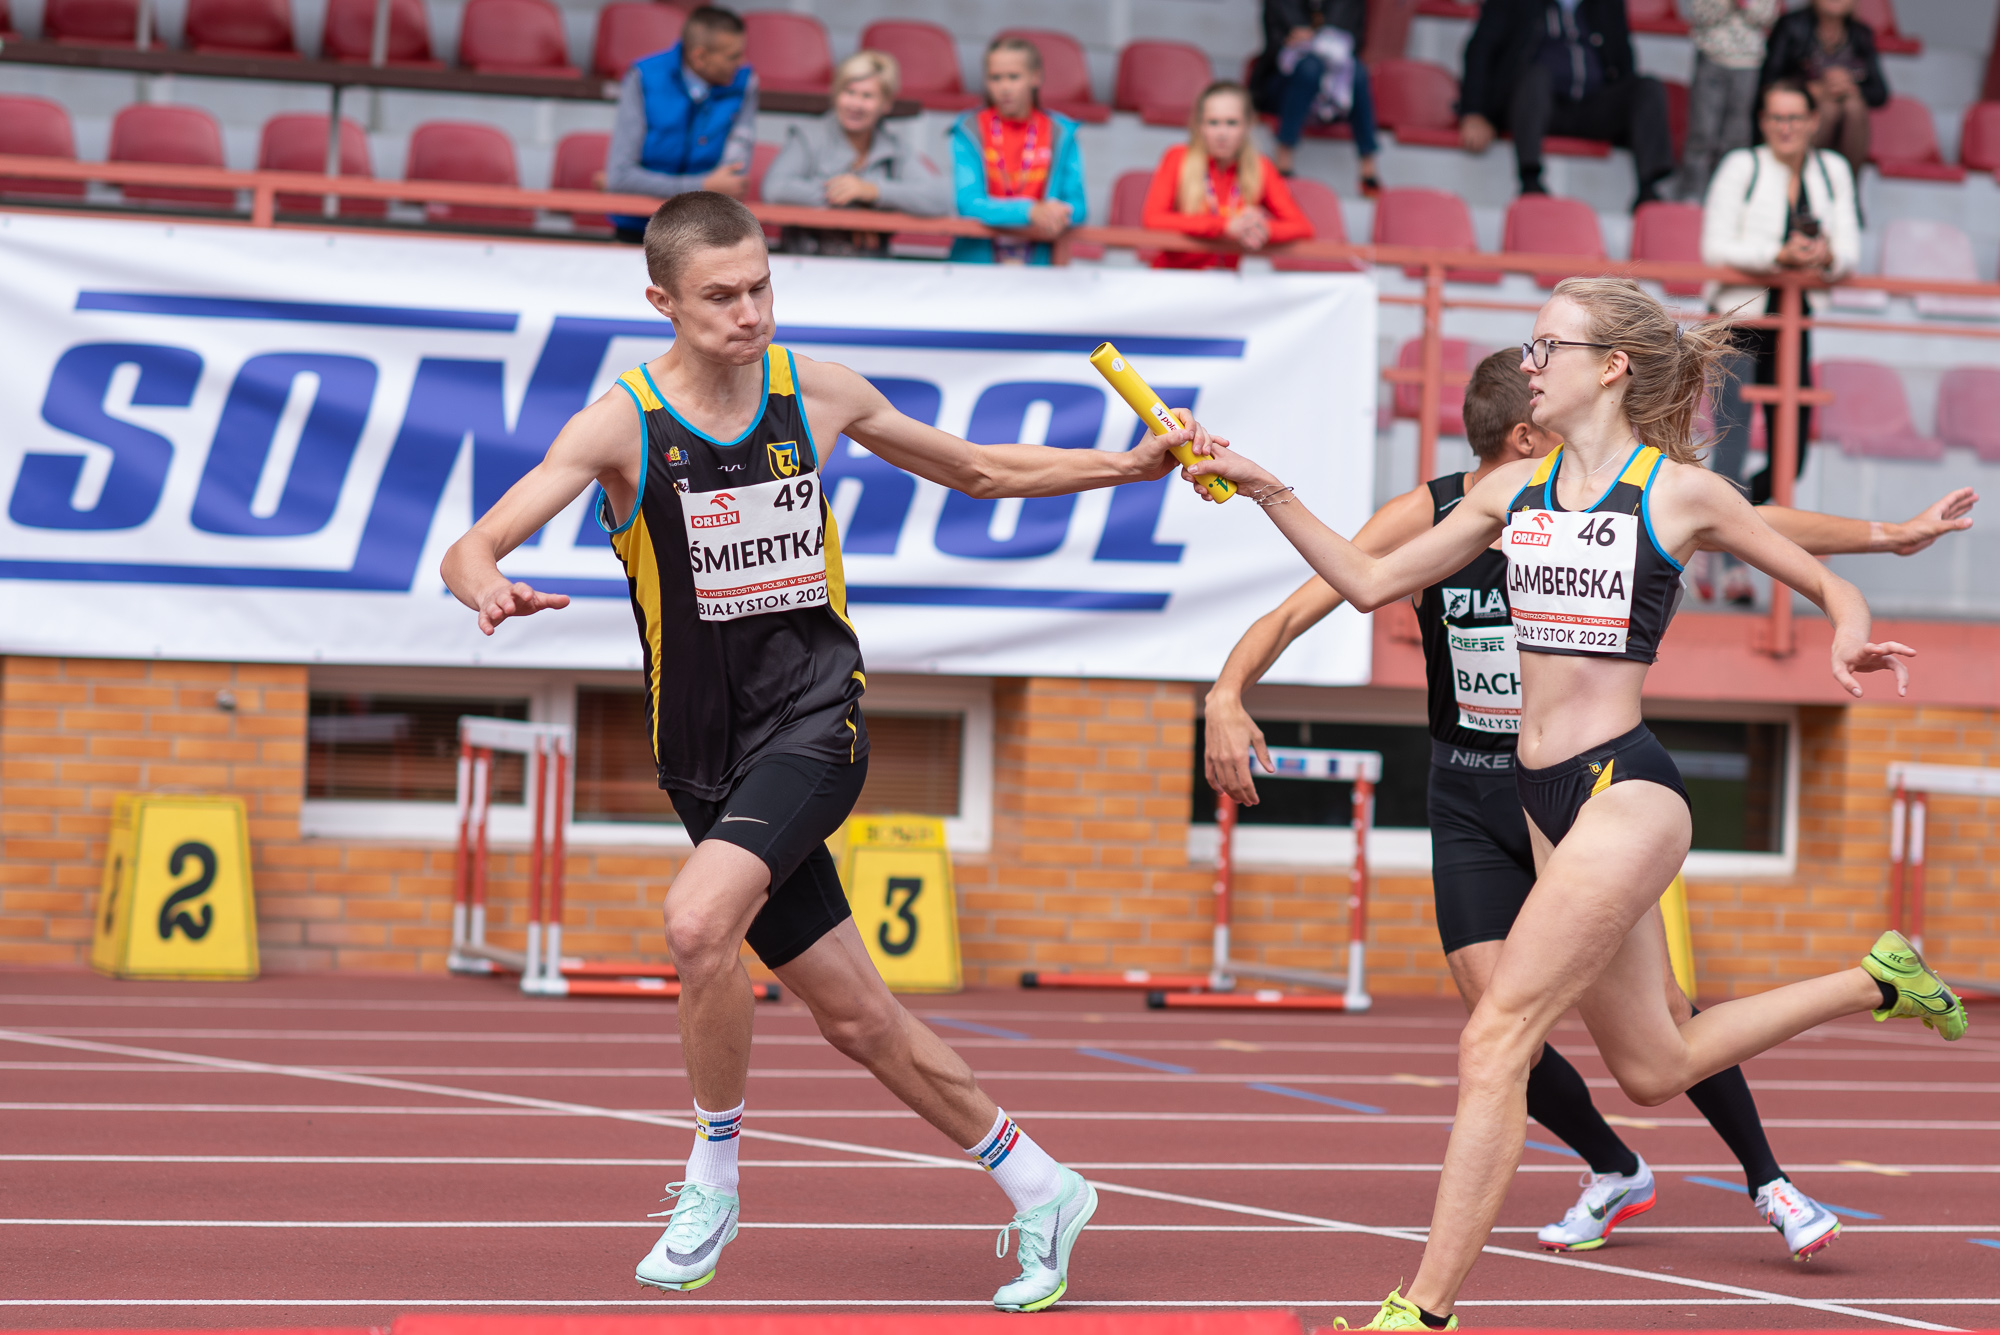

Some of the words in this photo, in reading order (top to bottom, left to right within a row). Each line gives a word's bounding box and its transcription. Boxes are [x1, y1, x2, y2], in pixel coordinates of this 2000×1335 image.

[8, 318, 1198, 592] SONROL
[773, 479, 814, 512] 49
[692, 512, 738, 527] ORLEN
[1512, 532, 1550, 546] ORLEN
[1577, 517, 1616, 547] 46
[691, 525, 825, 574] ŚMIERTKA
[709, 585, 762, 597] MISTRZOSTWA
[762, 579, 788, 590] POLSKI
[788, 578, 797, 586] W
[1508, 563, 1626, 601] LAMBERSKA
[698, 592, 791, 616] BIAŁYSTOK
[1557, 615, 1576, 623] POLSKI
[1583, 617, 1625, 626] SZTAFETACH
[1578, 630, 1618, 647] 2022
[1467, 713, 1521, 730] BIAŁYST
[1450, 749, 1512, 769] NIKE
[158, 841, 217, 940] 2
[878, 877, 923, 957] 3
